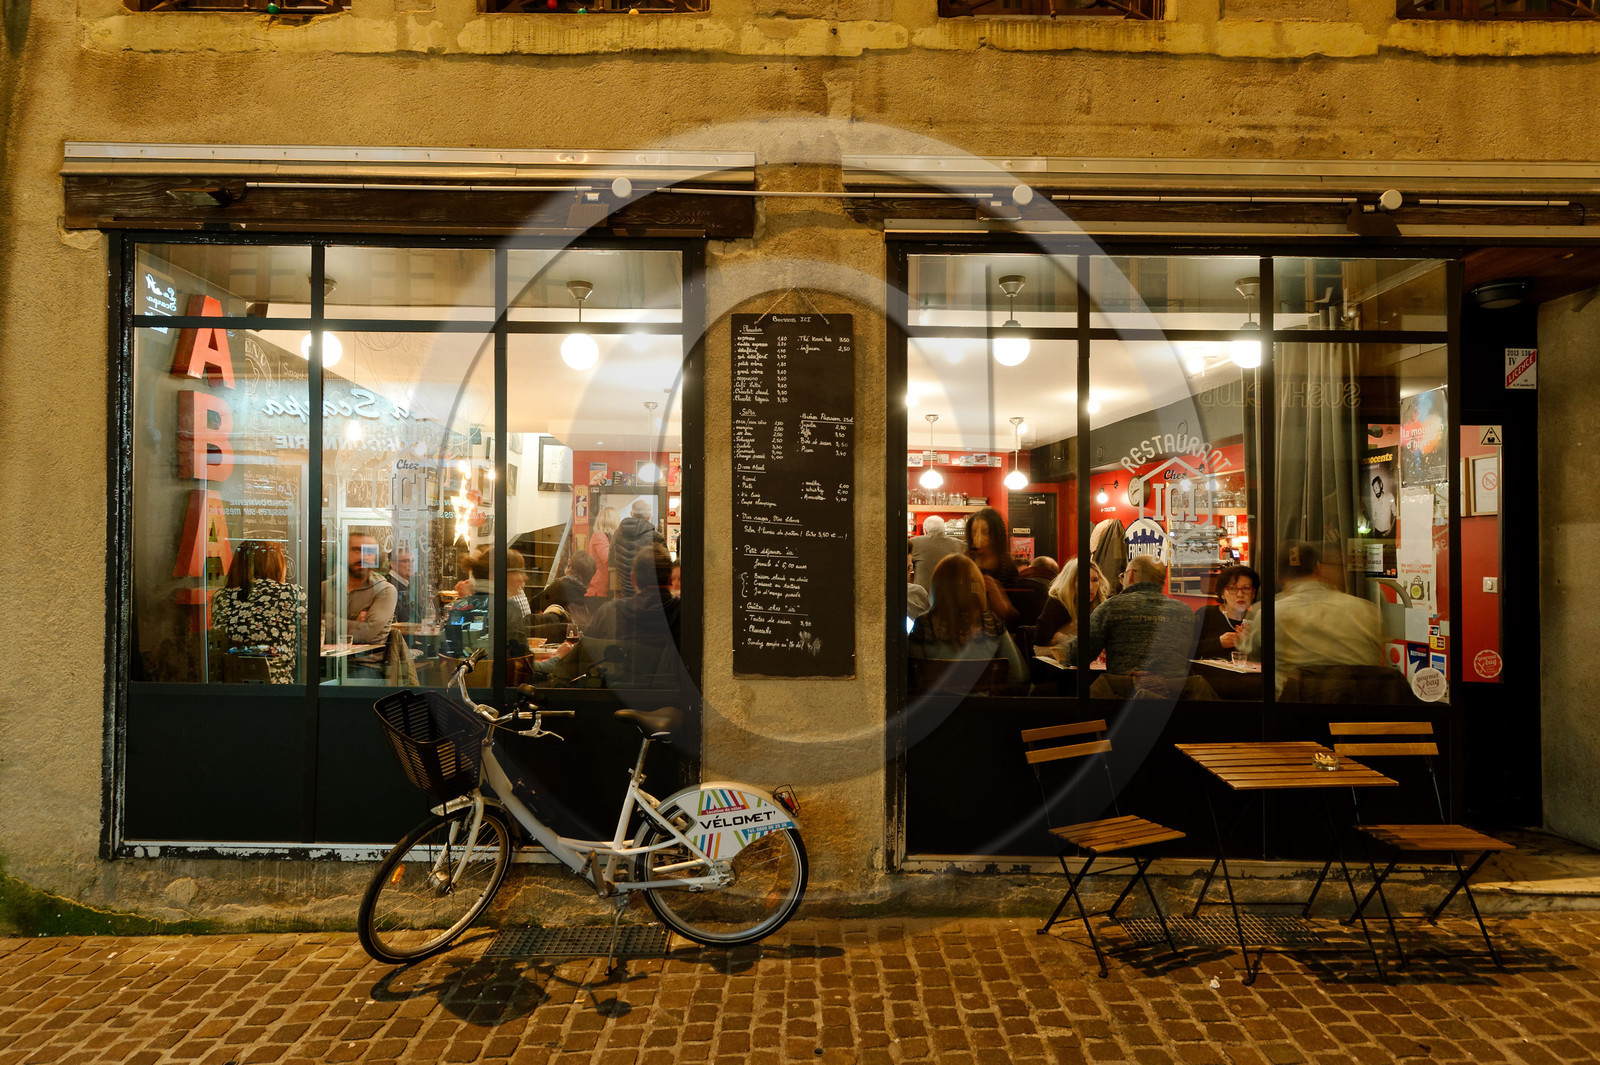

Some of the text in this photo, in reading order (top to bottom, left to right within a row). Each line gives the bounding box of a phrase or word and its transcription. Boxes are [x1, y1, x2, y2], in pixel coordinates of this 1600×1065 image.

[1508, 354, 1534, 384] LICENCE
[396, 459, 420, 470] Chez
[1120, 433, 1232, 474] RESTAURANT
[1163, 468, 1189, 480] Chez
[385, 473, 430, 511] ICI
[1152, 483, 1199, 522] ICI
[1425, 678, 1440, 687] bag
[699, 810, 776, 830] VÉLOMET'
